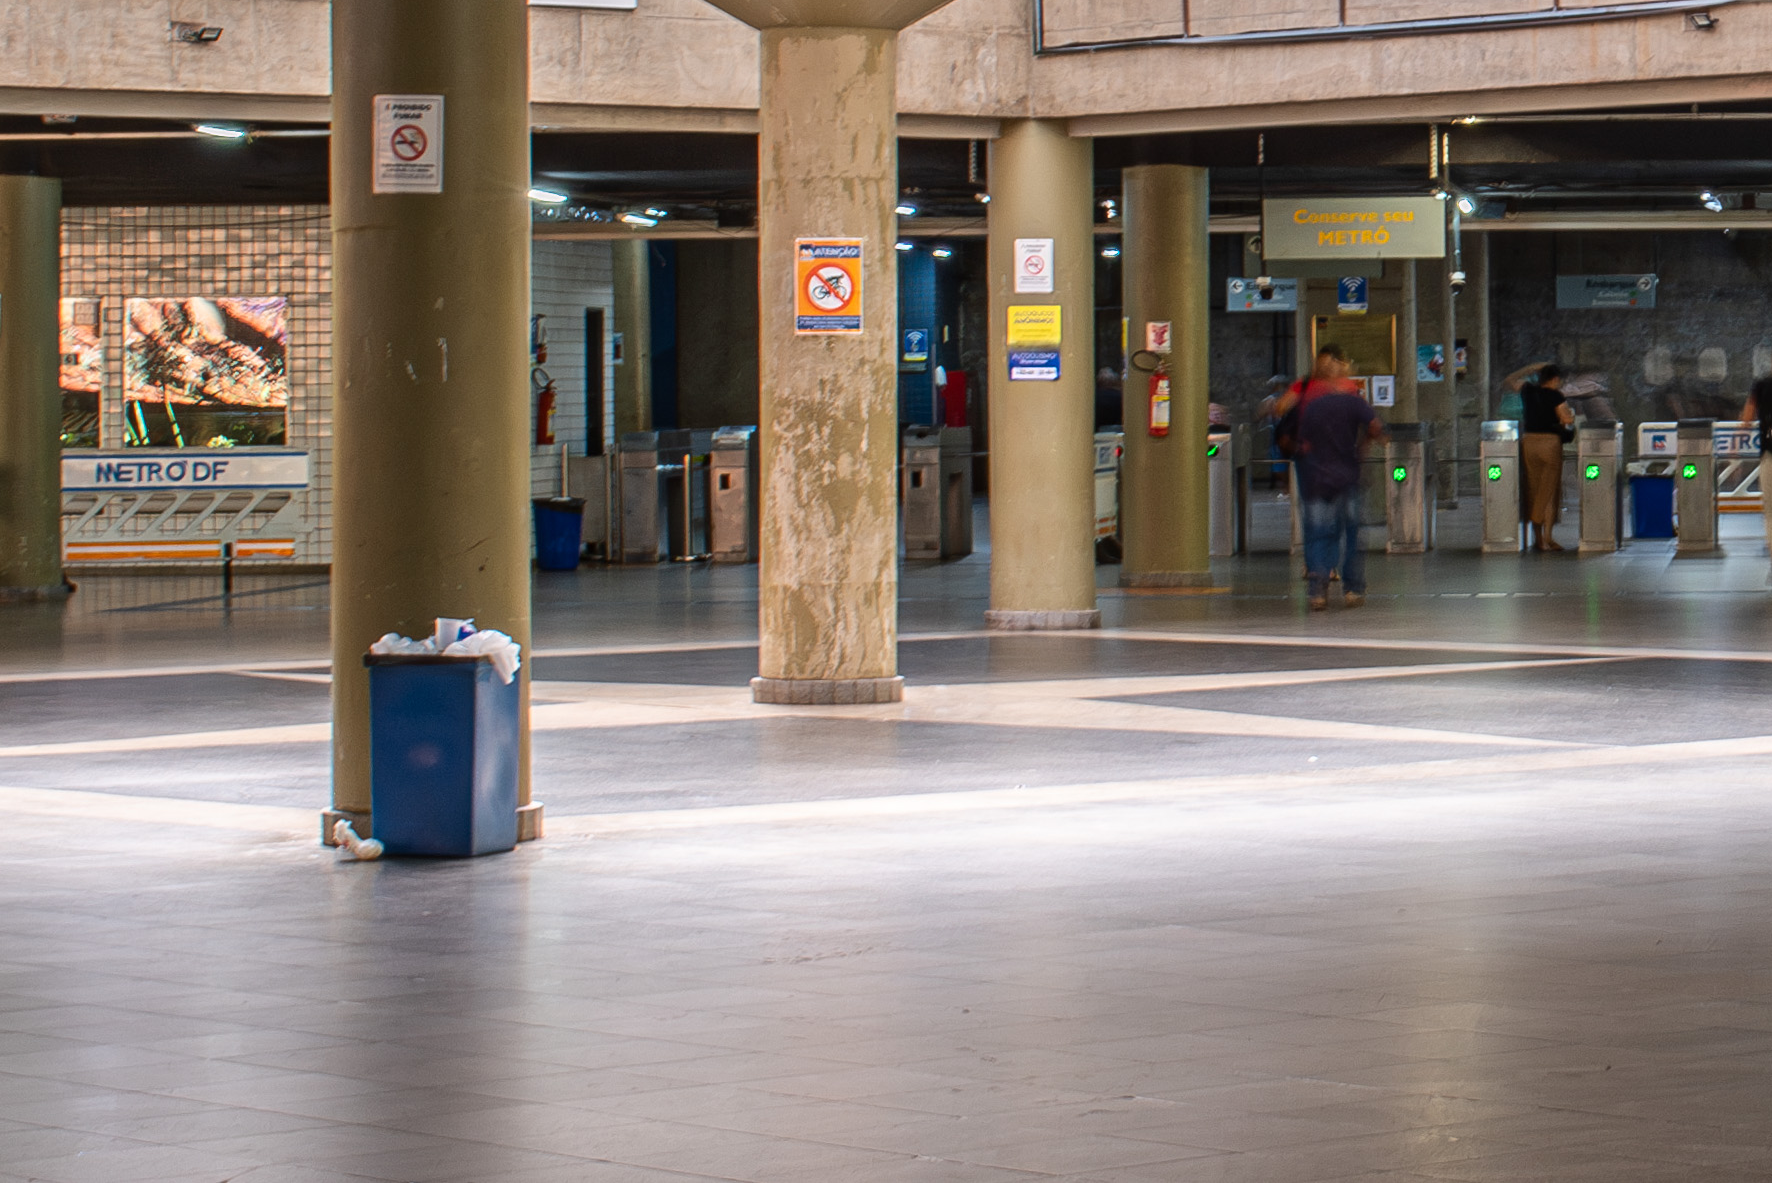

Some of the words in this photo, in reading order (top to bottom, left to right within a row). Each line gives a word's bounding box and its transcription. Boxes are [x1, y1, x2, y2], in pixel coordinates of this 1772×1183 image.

[1294, 209, 1379, 224] Conserve
[1383, 211, 1414, 222] seu
[814, 246, 859, 257] ATENÇÃO
[192, 461, 230, 482] DF
